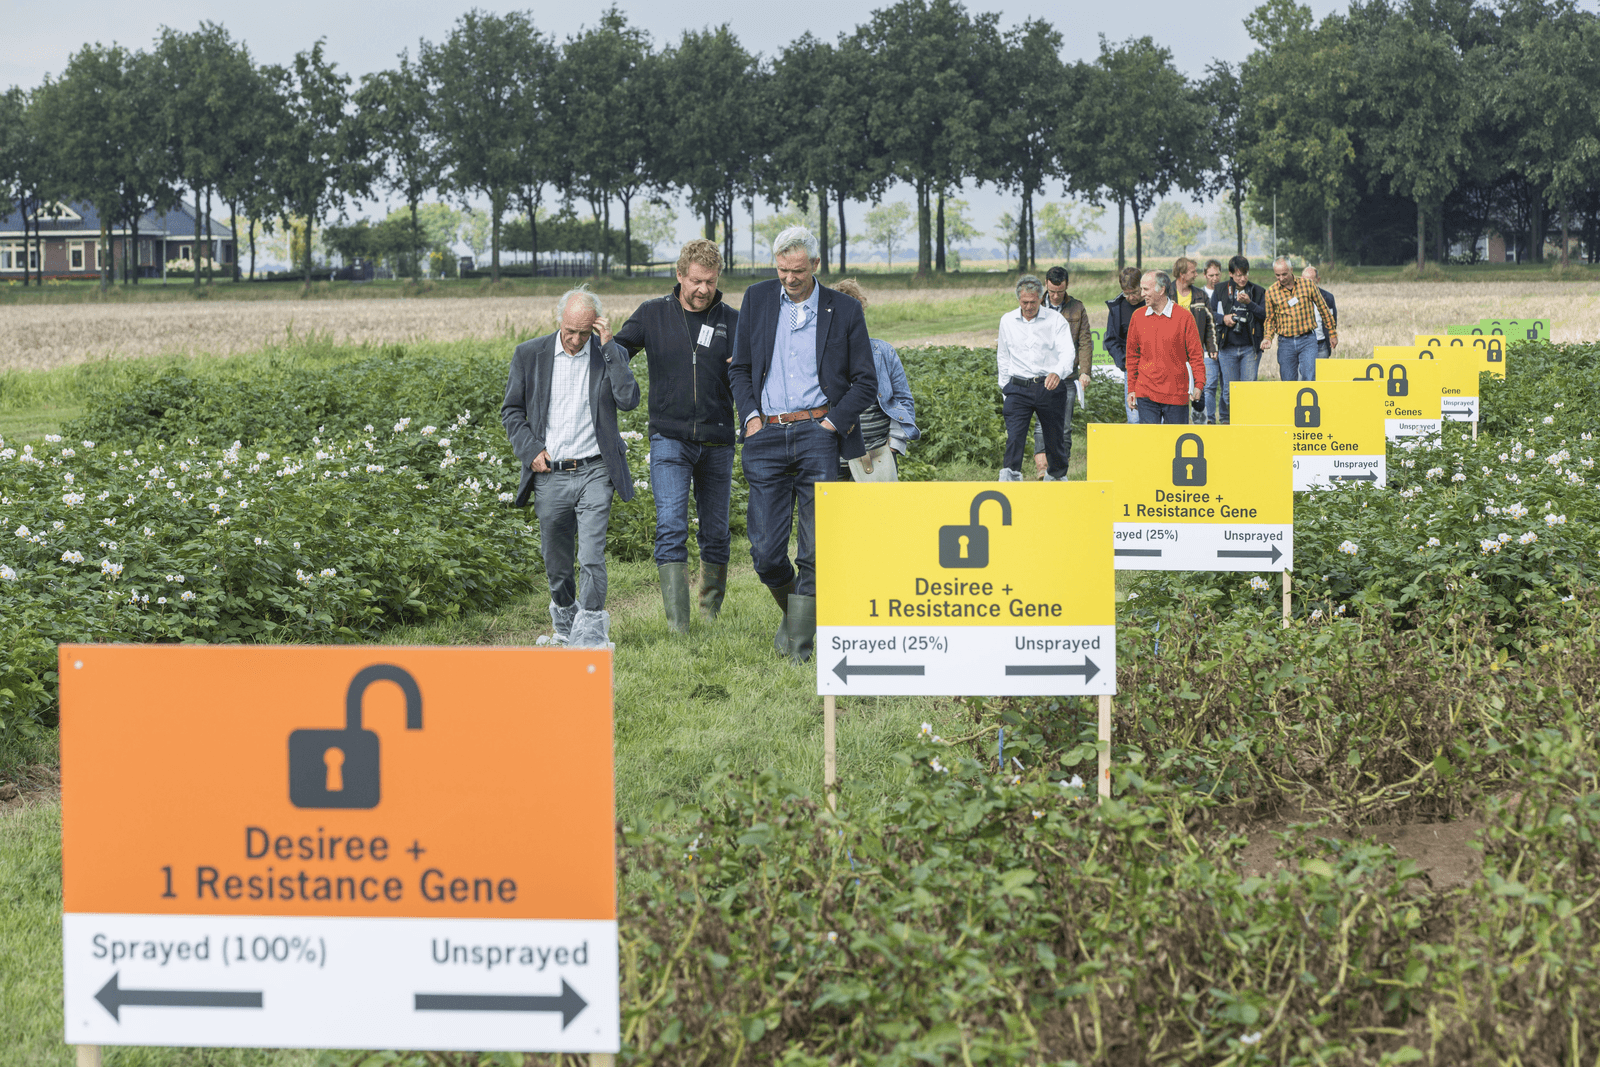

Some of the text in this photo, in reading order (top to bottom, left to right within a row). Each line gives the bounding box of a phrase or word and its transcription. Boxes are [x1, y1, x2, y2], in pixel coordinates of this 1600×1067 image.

[1395, 408, 1422, 416] Genes
[1293, 430, 1323, 440] esiree
[1293, 441, 1358, 451] stance Gene
[1334, 460, 1378, 469] Unsprayed
[1156, 490, 1209, 502] Desiree
[1124, 504, 1257, 518] 1 Resistance Gene
[1114, 530, 1178, 541] ayed (25%)
[1225, 531, 1282, 542] Unsprayed
[916, 578, 1013, 595] Desiree +
[870, 599, 1062, 617] 1 Resistance Gene
[832, 636, 947, 653] Sprayed (25%)
[1016, 636, 1100, 653] Unsprayed
[246, 827, 425, 861] Desiree +
[162, 866, 517, 903] 1 Resistance Gene
[93, 934, 325, 967] Sprayed (100%)
[433, 939, 588, 971] Unsprayed
